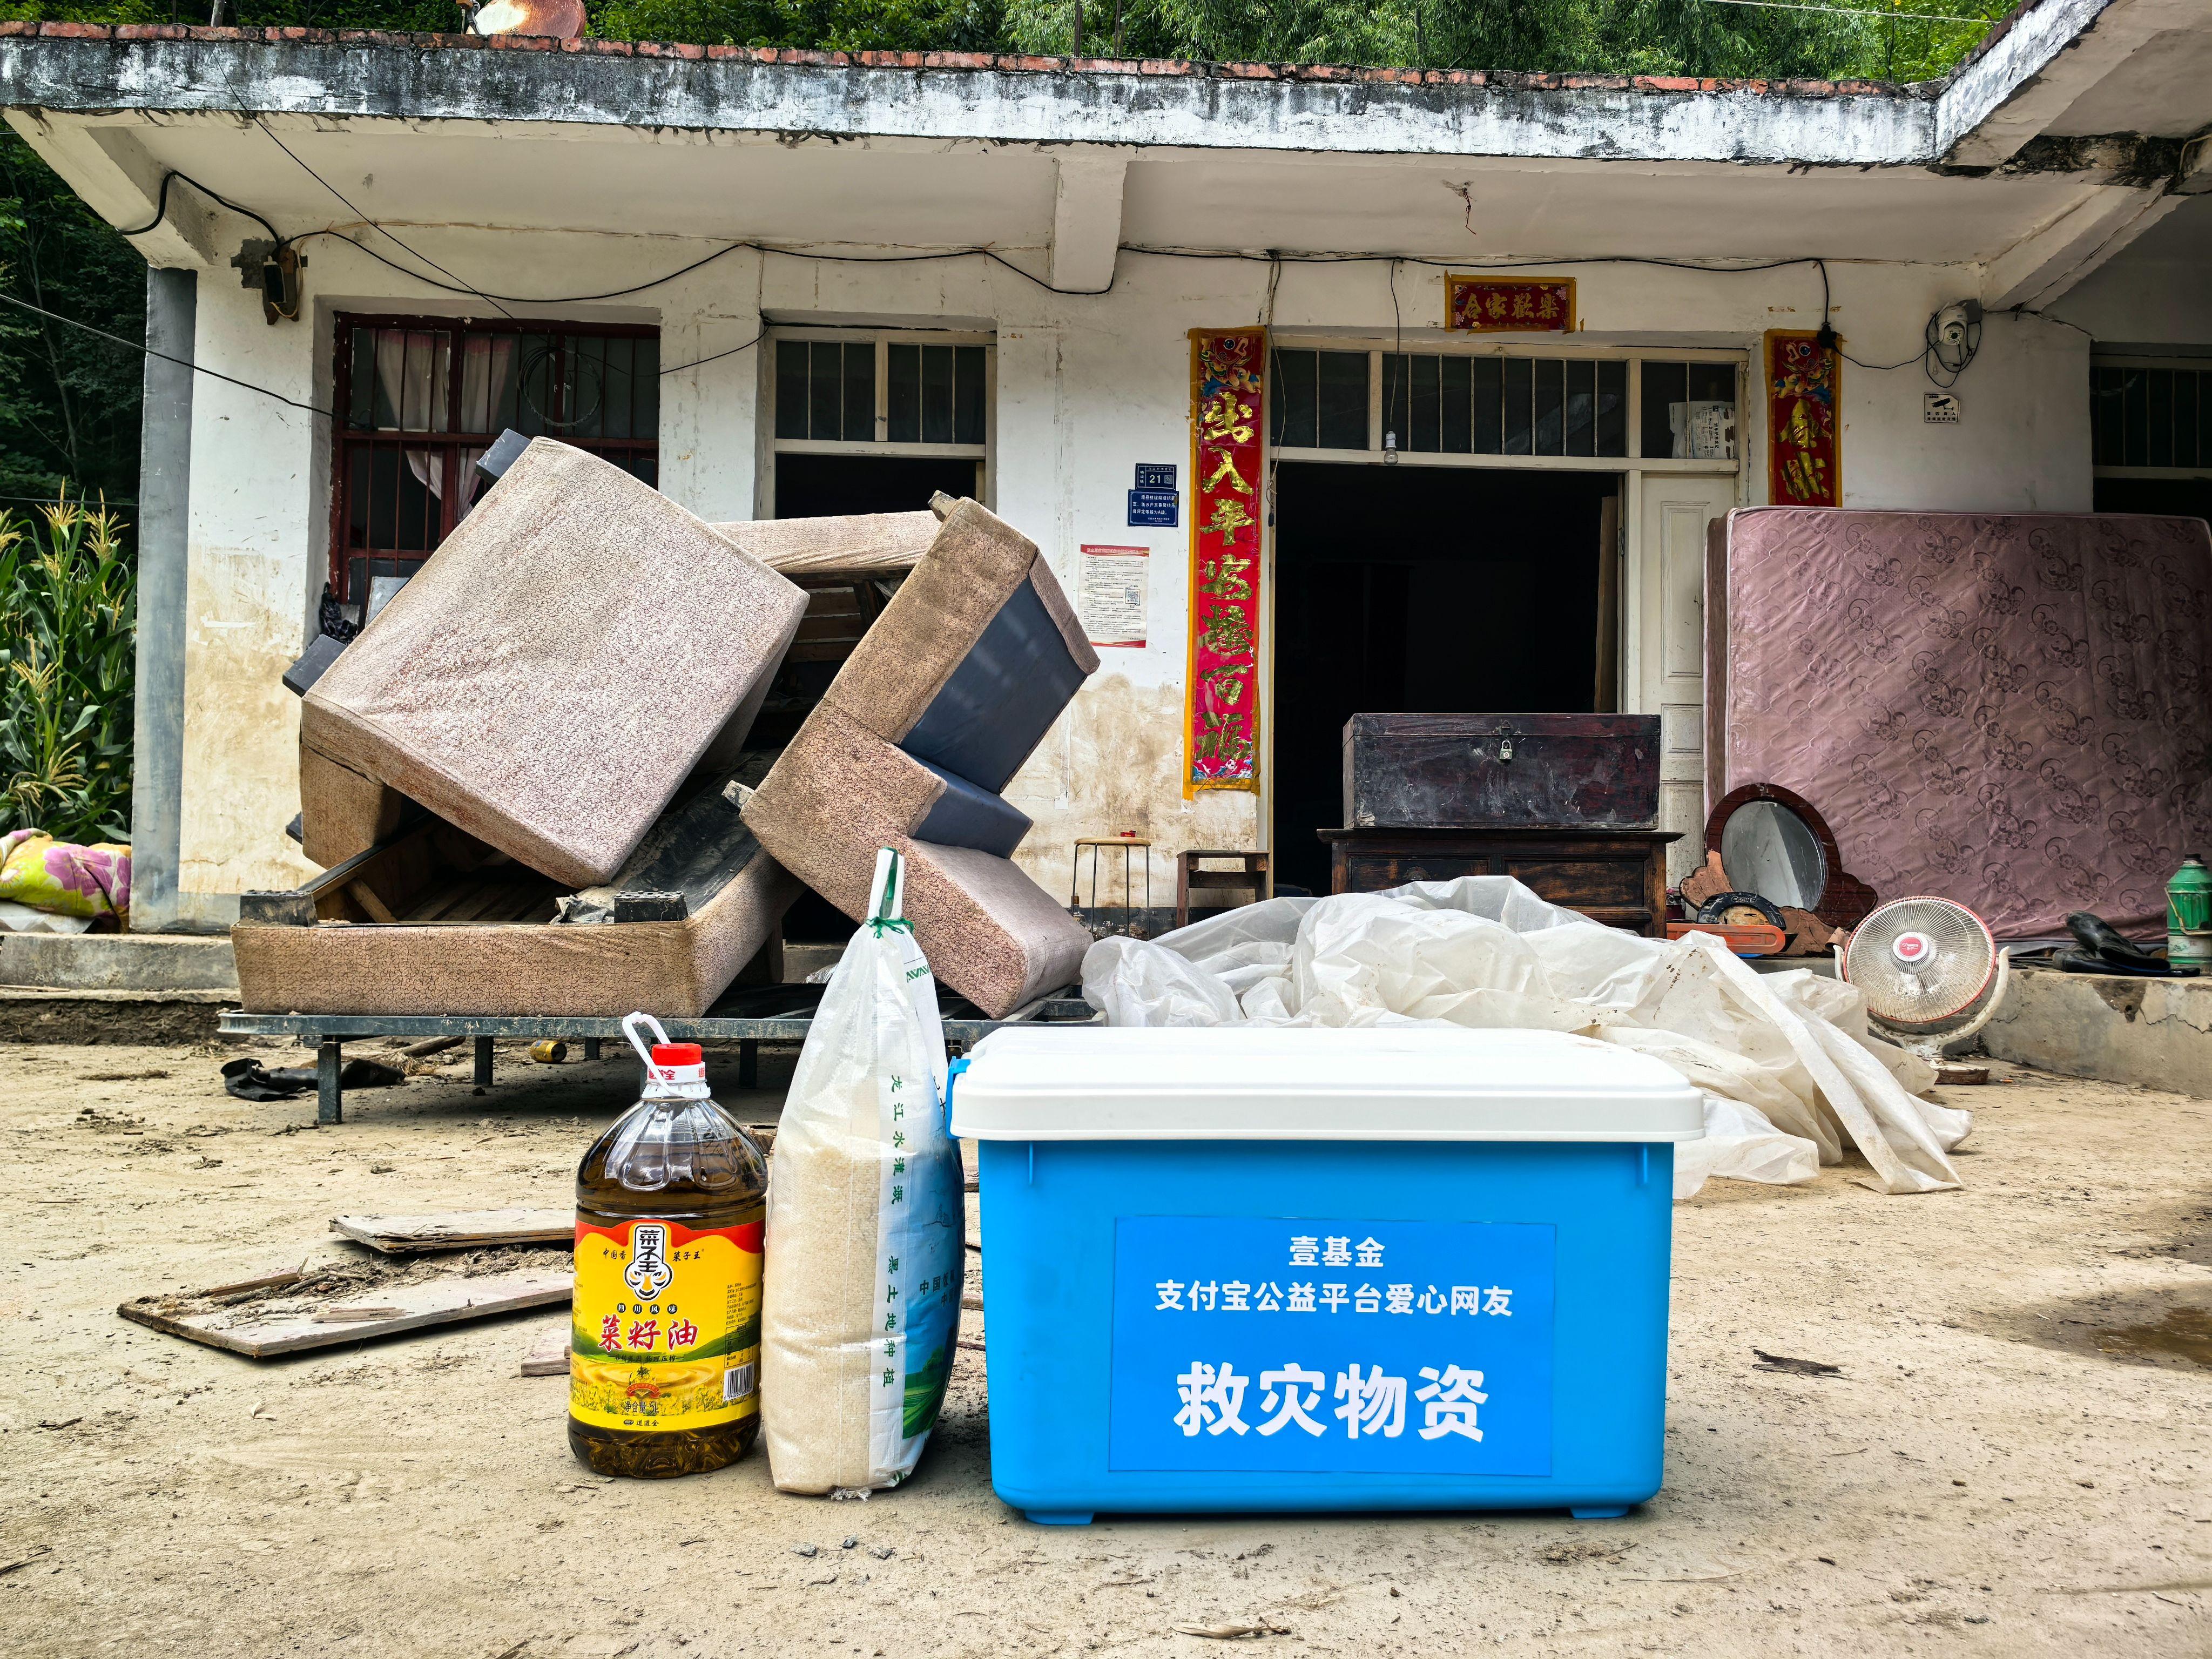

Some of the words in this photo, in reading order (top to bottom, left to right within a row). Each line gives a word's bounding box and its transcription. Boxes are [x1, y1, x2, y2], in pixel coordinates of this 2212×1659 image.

[1149, 474, 1161, 484] 21
[891, 1075, 905, 1205] 龙江水灌溉
[603, 1247, 626, 1260] 中国香
[638, 1229, 660, 1272] 菜子王
[1288, 1235, 1385, 1267] 壹基金
[617, 1303, 678, 1314] 四川风味
[1155, 1279, 1513, 1317] 支付宝公益平台爱心网友
[597, 1313, 699, 1352] 菜籽油
[883, 1255, 899, 1388] 黑土地种植
[1173, 1360, 1490, 1444] 救灾物资
